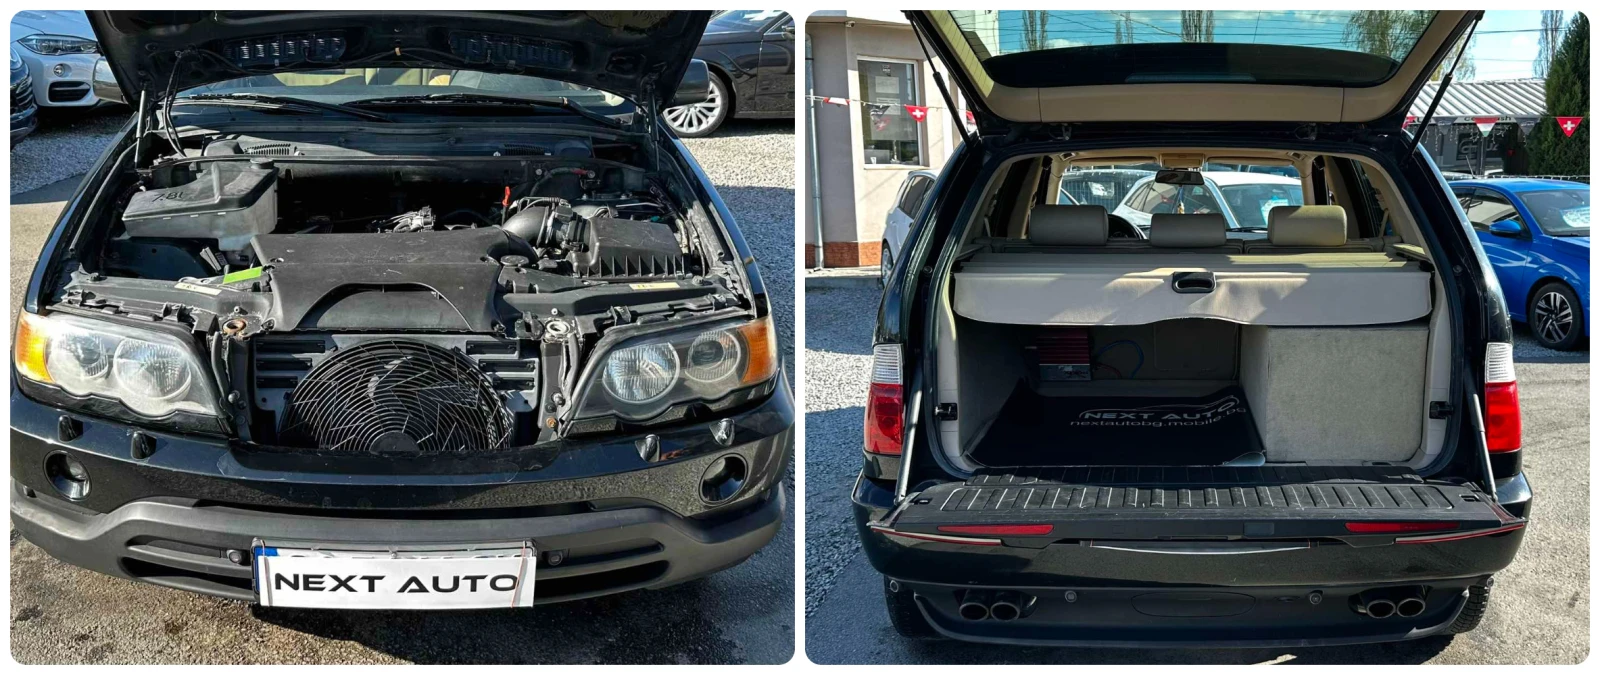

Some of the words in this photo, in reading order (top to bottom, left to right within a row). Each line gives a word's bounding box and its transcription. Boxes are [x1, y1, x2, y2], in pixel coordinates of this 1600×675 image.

[1070, 407, 1247, 427] nextautobg.mobile.bg
[1161, 401, 1236, 420] AUTO
[275, 572, 386, 593] NEXT
[396, 574, 520, 593] AUTO
